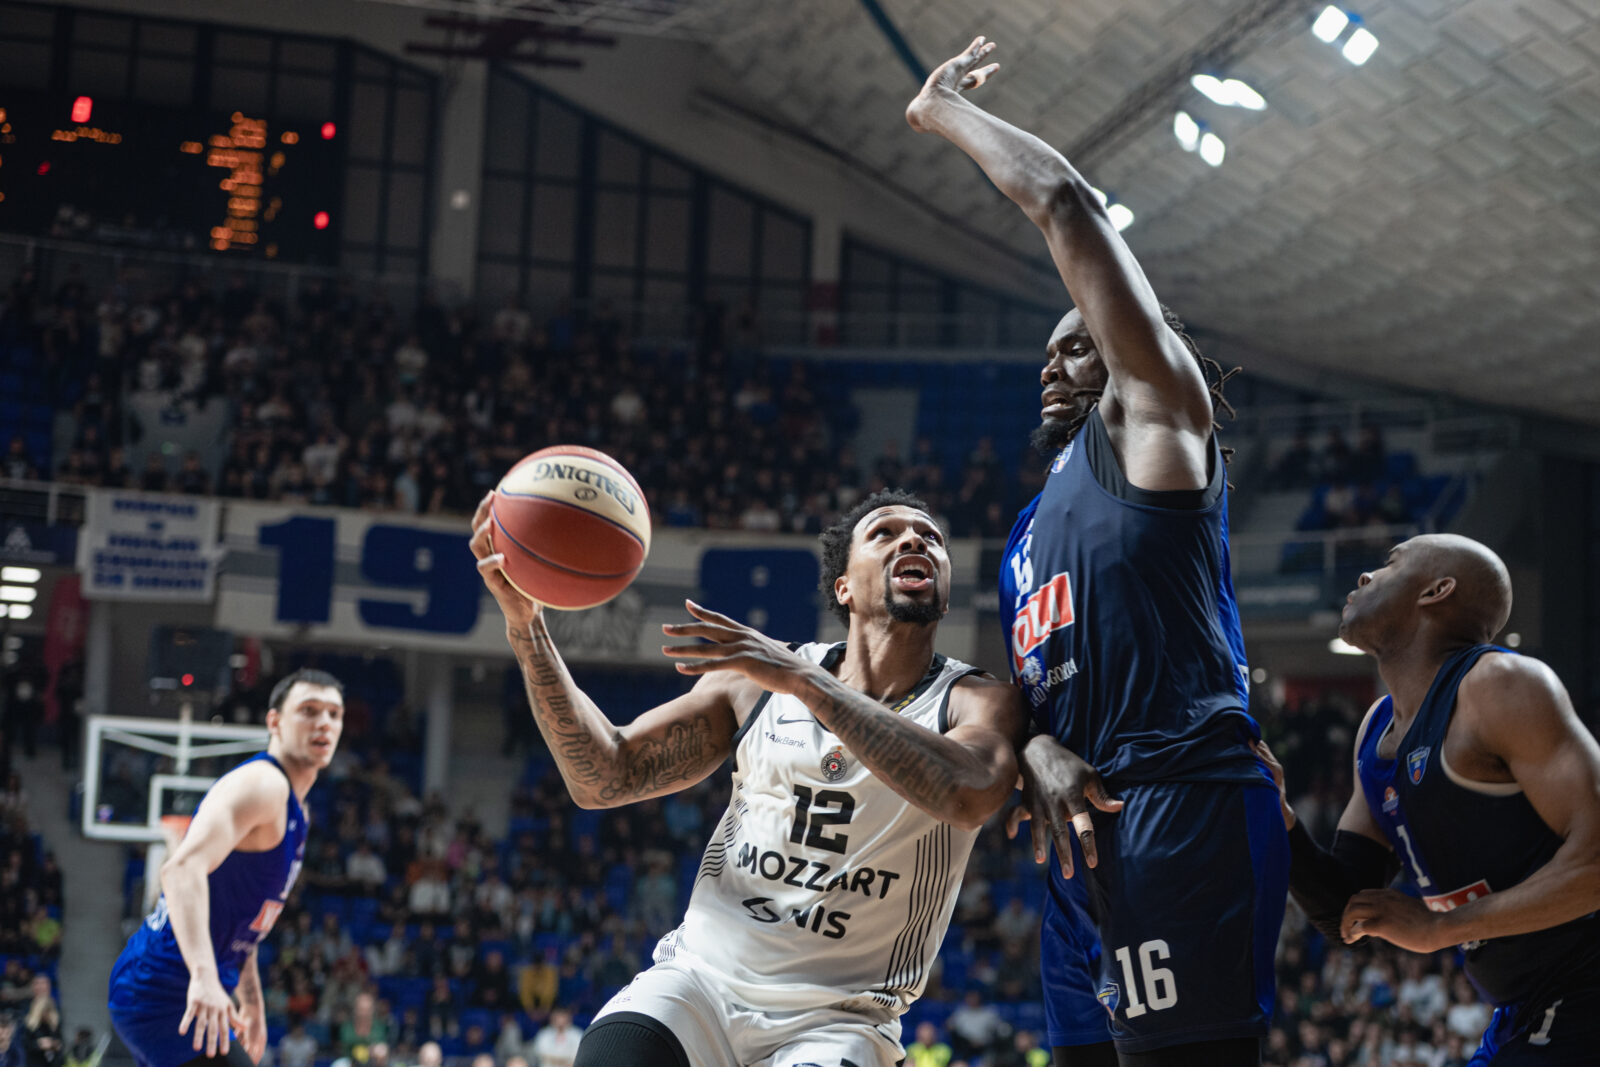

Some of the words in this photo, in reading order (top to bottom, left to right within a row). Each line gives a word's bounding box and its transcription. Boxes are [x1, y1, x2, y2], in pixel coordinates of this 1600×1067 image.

[533, 462, 637, 516] SPALDING
[789, 784, 856, 855] 12
[736, 842, 900, 900] MOZZART
[1396, 824, 1431, 888] 1
[792, 904, 852, 940] NIS
[1114, 938, 1179, 1019] 16
